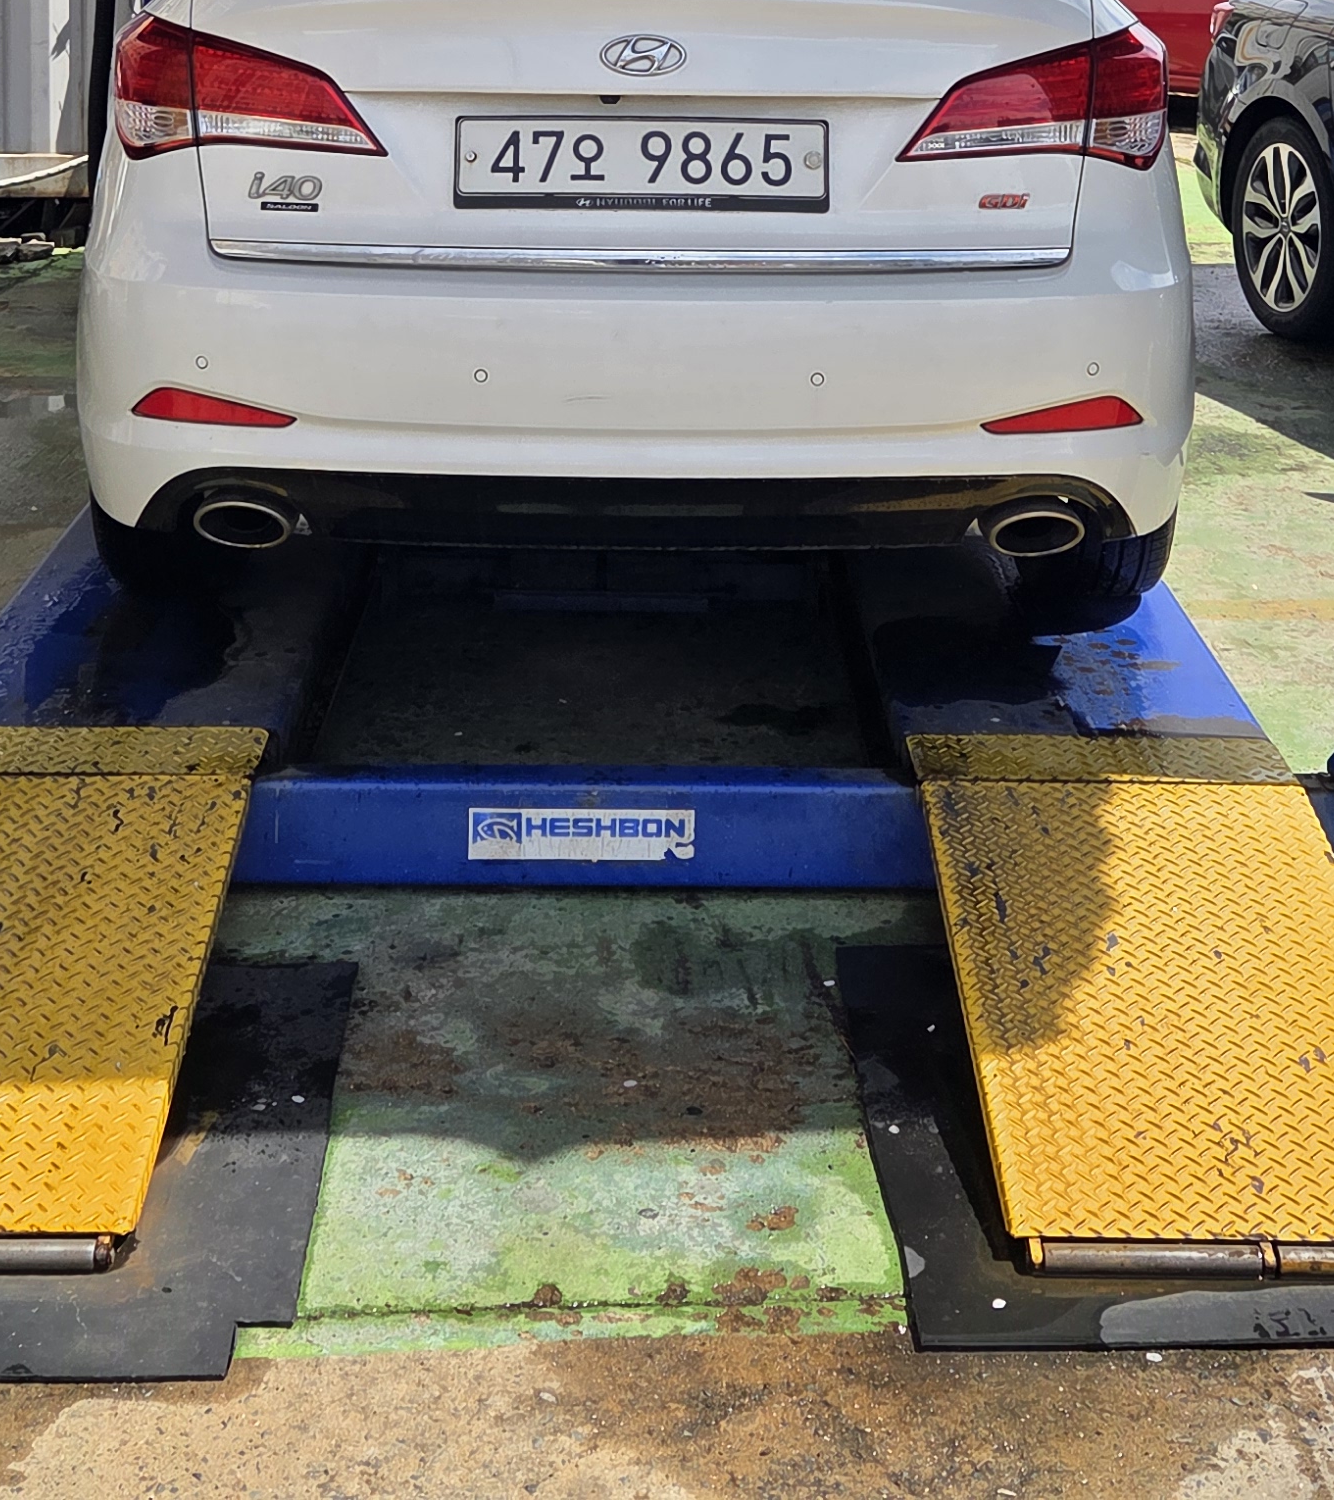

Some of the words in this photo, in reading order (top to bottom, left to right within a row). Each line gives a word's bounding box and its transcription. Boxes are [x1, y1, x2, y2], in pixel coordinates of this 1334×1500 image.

[490, 130, 605, 183] 47오
[640, 130, 793, 187] 9865
[247, 171, 323, 201] i40
[265, 203, 313, 211] SALOON
[978, 192, 1030, 210] GDi
[525, 817, 686, 839] HESHBON
